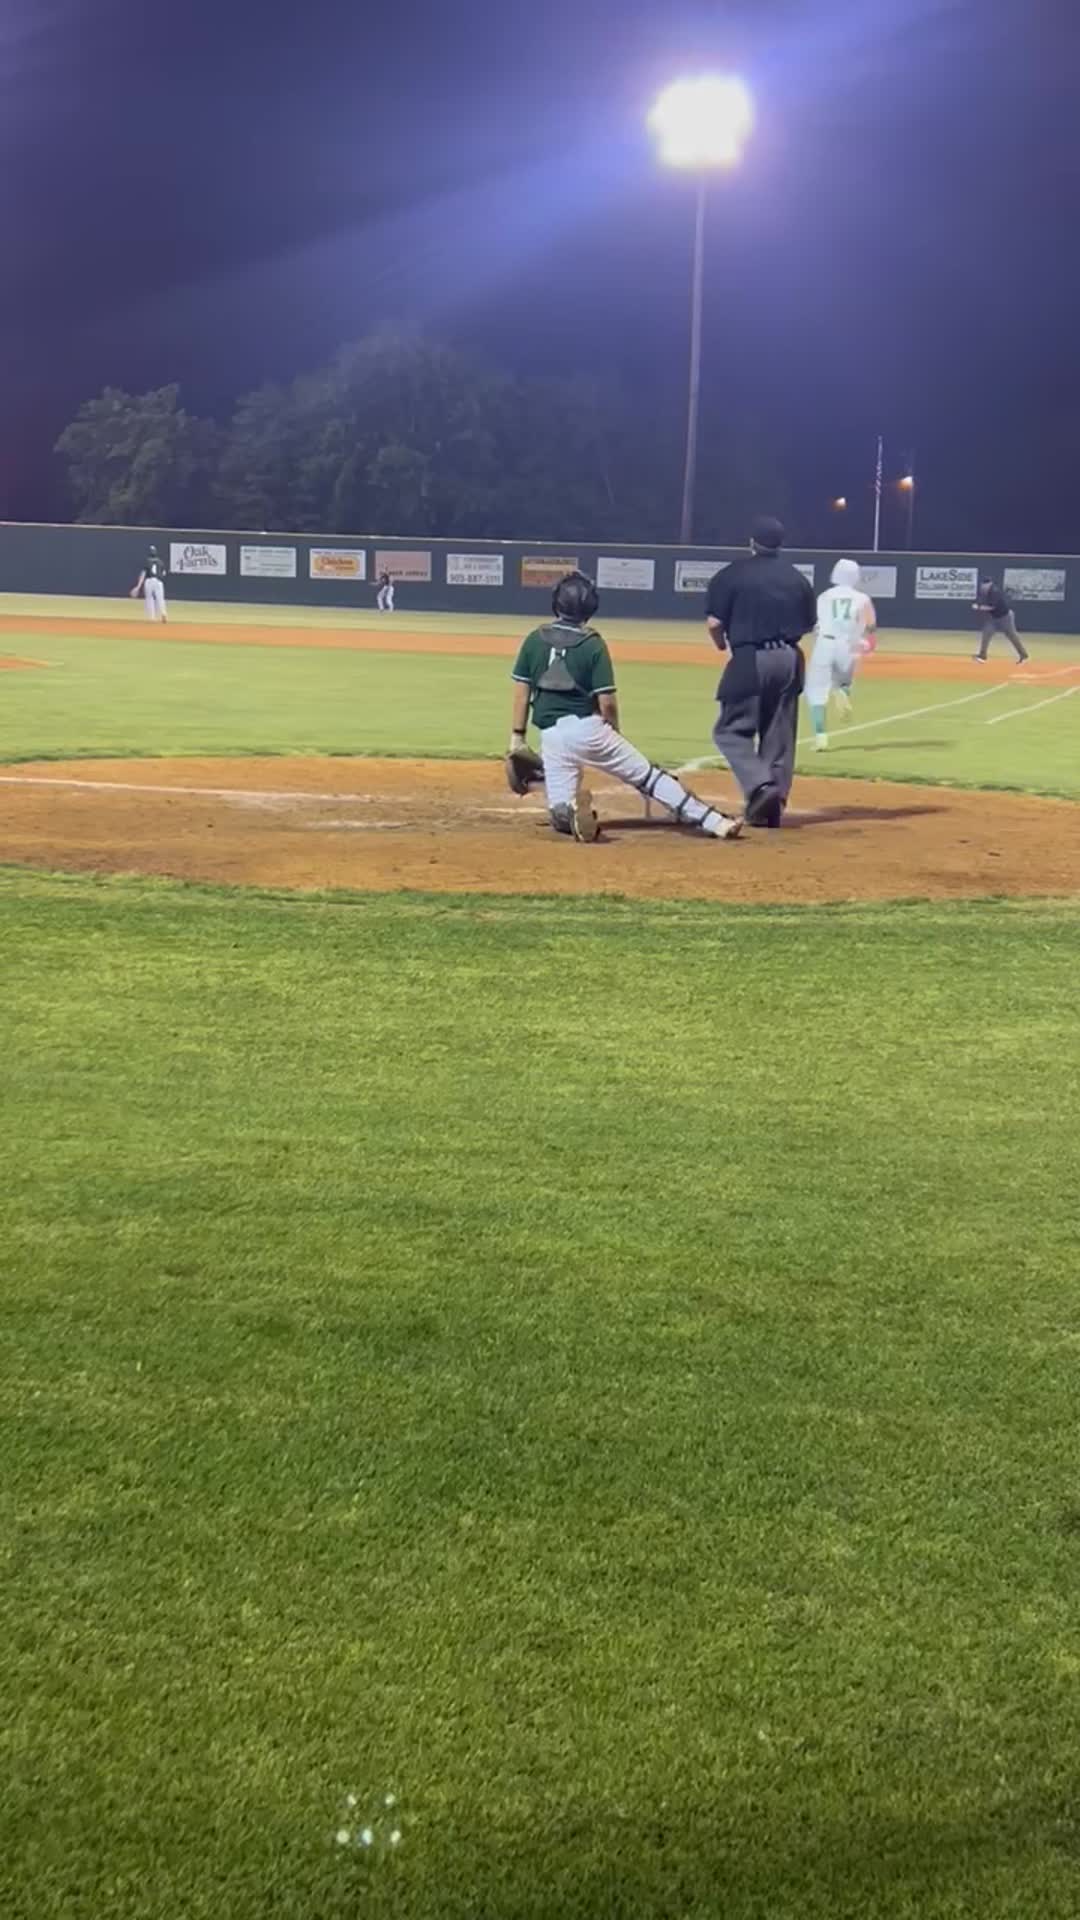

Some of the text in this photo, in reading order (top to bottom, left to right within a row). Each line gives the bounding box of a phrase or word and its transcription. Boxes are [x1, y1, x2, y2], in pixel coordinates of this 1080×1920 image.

[183, 545, 212, 560] Oak
[176, 557, 219, 571] Farms
[832, 598, 852, 620] 17
